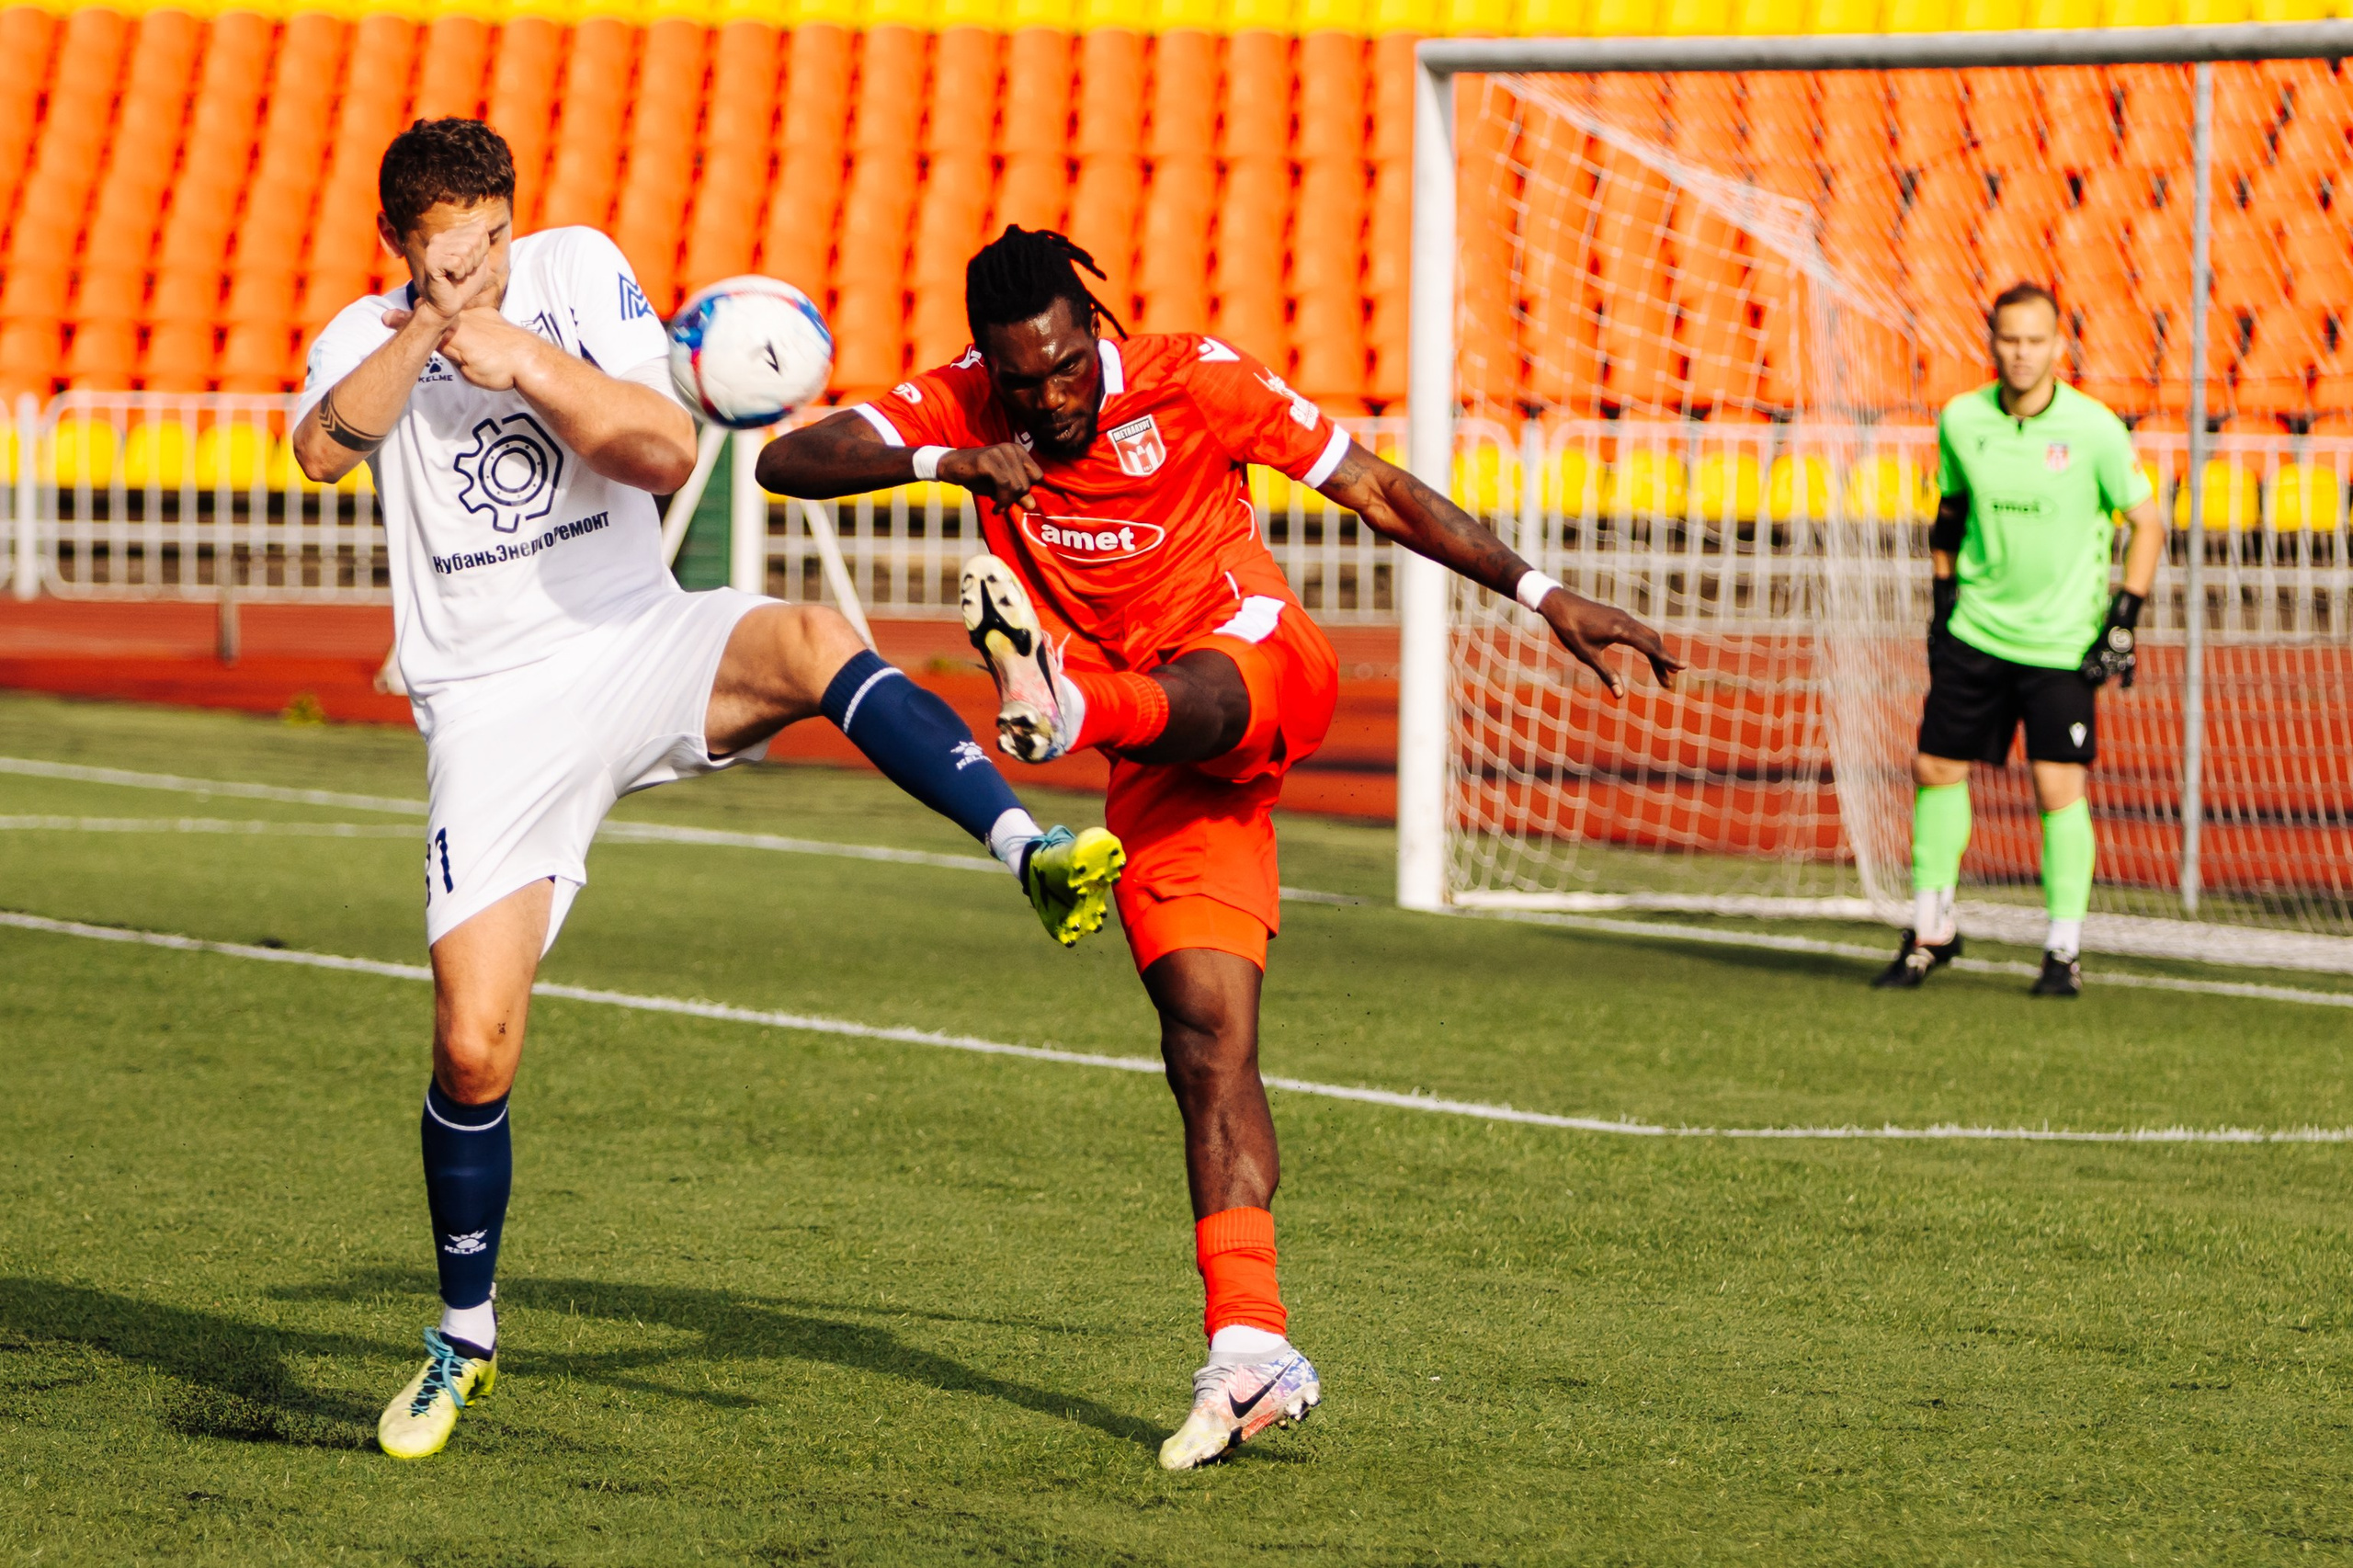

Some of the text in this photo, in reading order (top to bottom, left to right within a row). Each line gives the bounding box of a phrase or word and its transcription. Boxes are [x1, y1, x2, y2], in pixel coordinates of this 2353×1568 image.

[418, 374, 453, 383] KELME
[1040, 524, 1136, 551] amet
[444, 1243, 487, 1255] KELME
